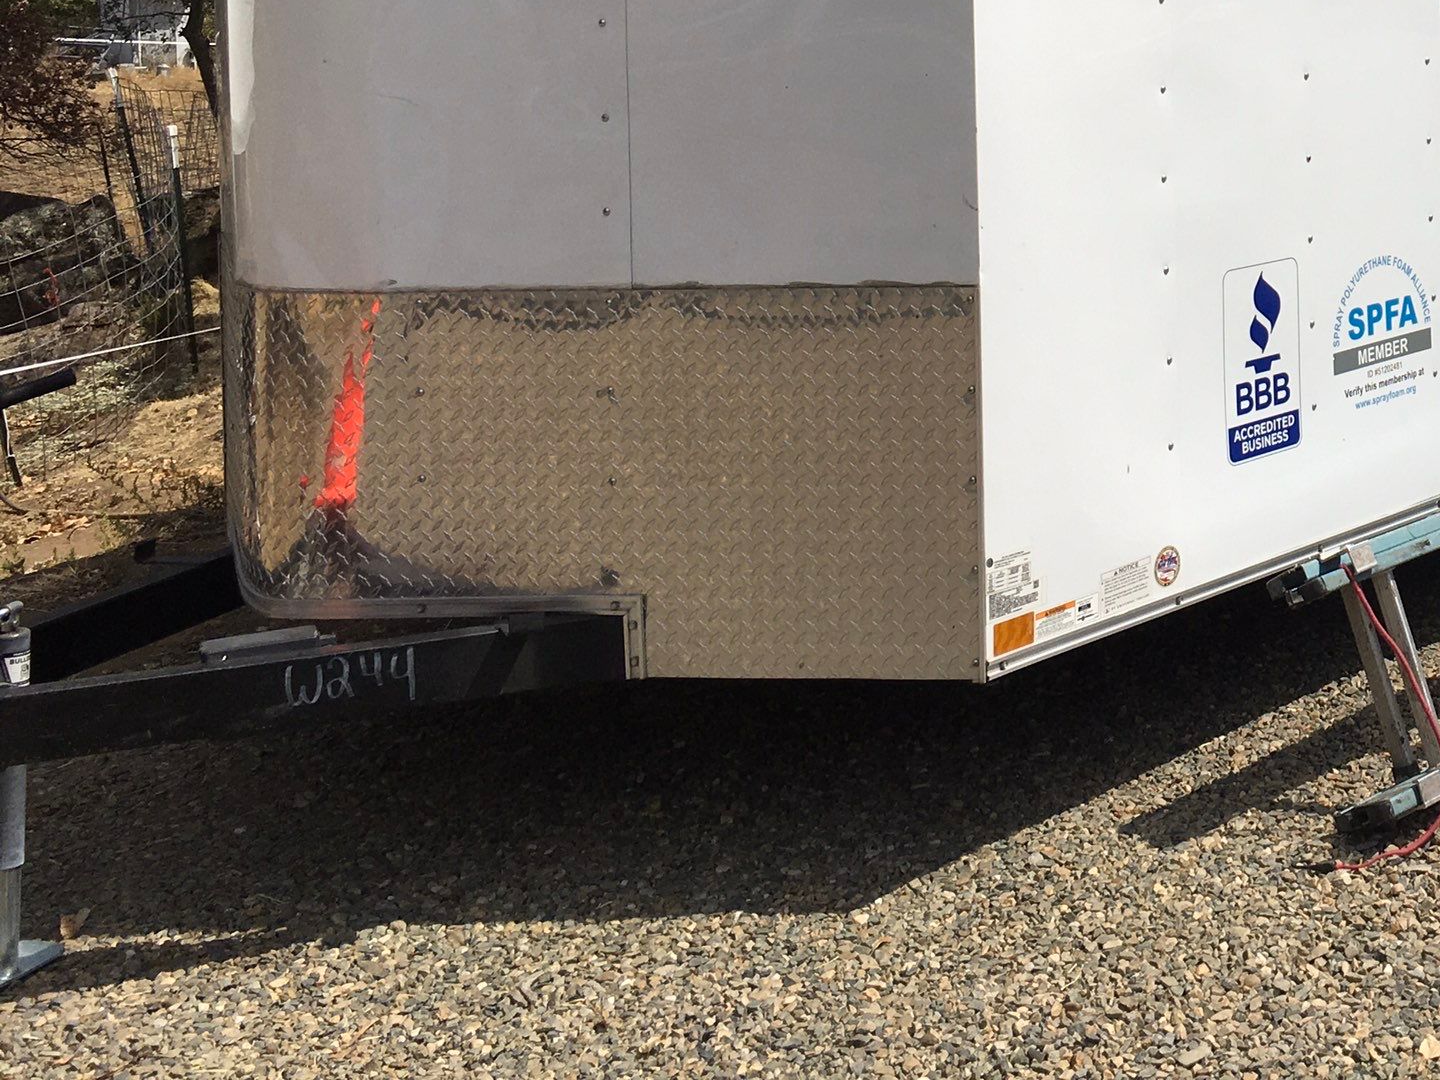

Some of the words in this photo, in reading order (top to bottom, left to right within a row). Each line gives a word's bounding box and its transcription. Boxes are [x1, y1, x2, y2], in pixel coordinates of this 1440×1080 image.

[1332, 307, 1344, 348] SPRAY
[1340, 255, 1391, 306] POLYURETHANE
[1393, 256, 1413, 277] FOAM
[1411, 273, 1431, 324] ALLIANCE
[1348, 295, 1418, 340] SPFA
[1358, 337, 1409, 365] MEMBER
[1236, 372, 1290, 416] BBB
[1344, 385, 1363, 398] Verify
[1365, 382, 1377, 393] this
[1378, 370, 1417, 388] membership
[1418, 368, 1424, 377] at
[1234, 414, 1295, 443] ACCREDITED
[1242, 429, 1289, 454] BUSINESS
